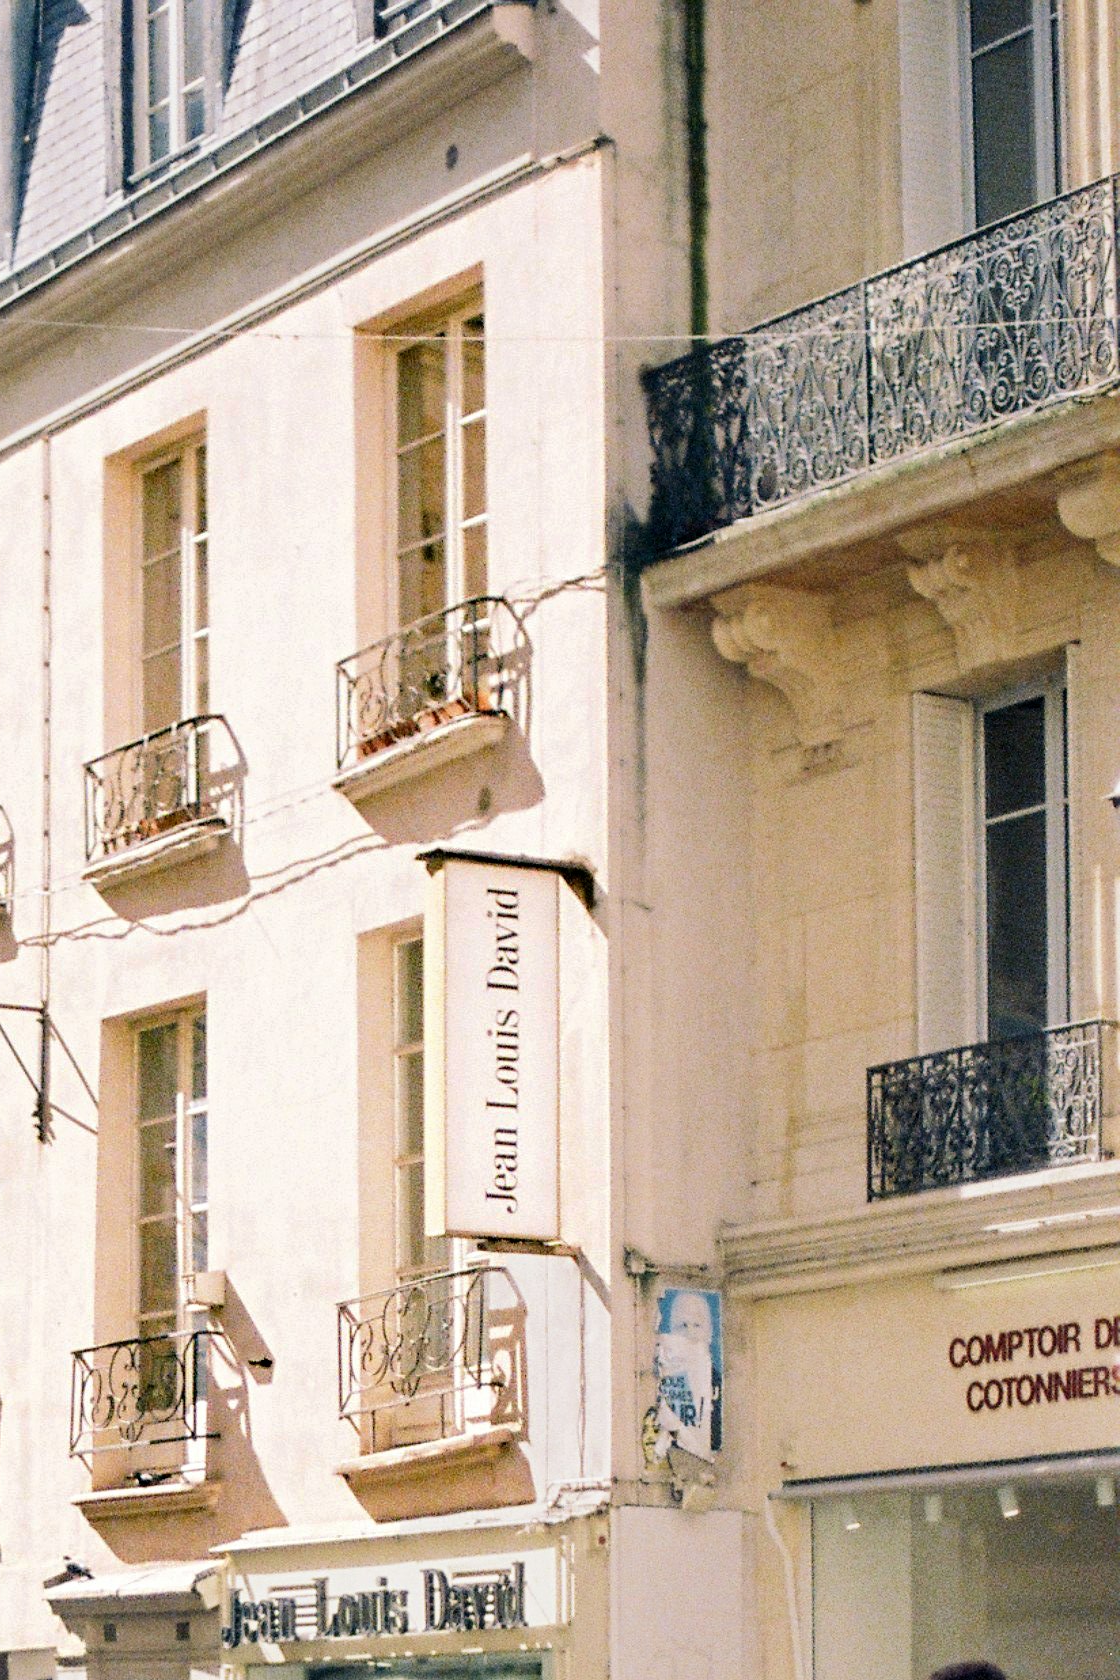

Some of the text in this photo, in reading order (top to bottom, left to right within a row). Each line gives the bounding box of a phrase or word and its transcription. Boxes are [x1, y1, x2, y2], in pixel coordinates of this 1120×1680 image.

[485, 888, 520, 1214] Jean Louis David
[949, 1322, 1081, 1368] COMPTOIR
[221, 1561, 529, 1649] Jean Louis David
